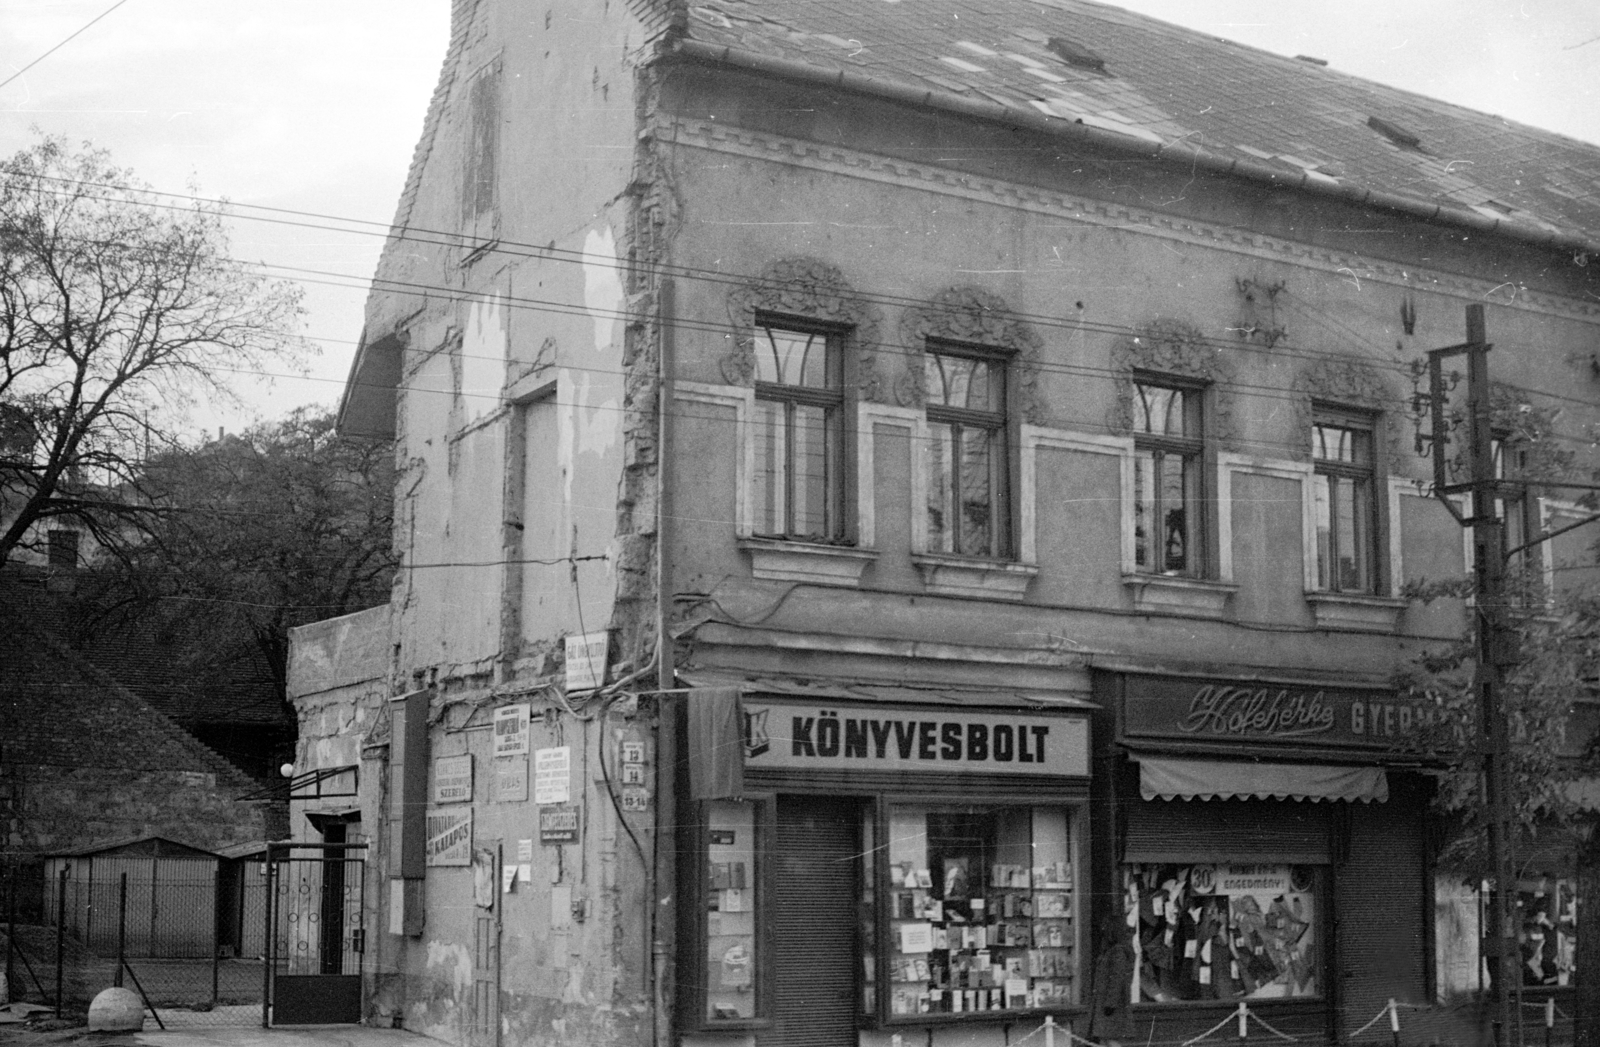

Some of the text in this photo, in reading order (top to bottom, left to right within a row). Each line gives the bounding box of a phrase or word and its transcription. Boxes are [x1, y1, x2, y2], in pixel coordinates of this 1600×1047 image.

[792, 710, 1050, 763] KÖNYVESBOLT
[629, 770, 639, 781] 14
[434, 822, 469, 857] KALAPOS
